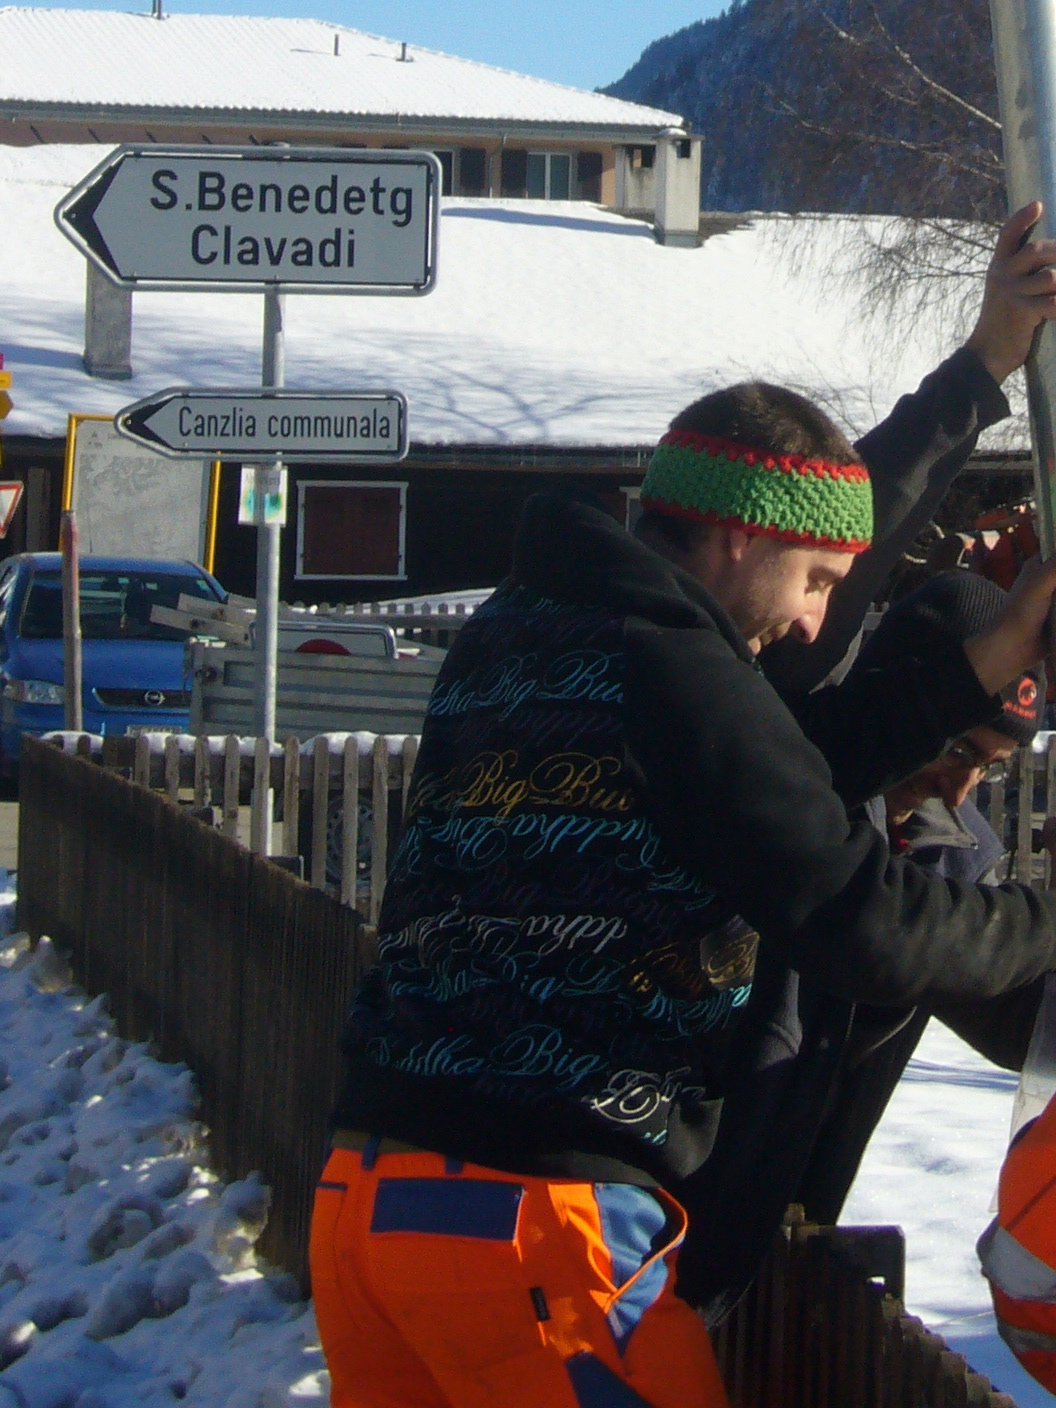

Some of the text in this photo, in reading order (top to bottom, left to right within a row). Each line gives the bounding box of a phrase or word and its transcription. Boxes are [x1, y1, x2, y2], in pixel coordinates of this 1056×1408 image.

[150, 169, 413, 227] S.Benedetg
[191, 225, 356, 267] Clavadi
[178, 406, 391, 439] Canzlia communala
